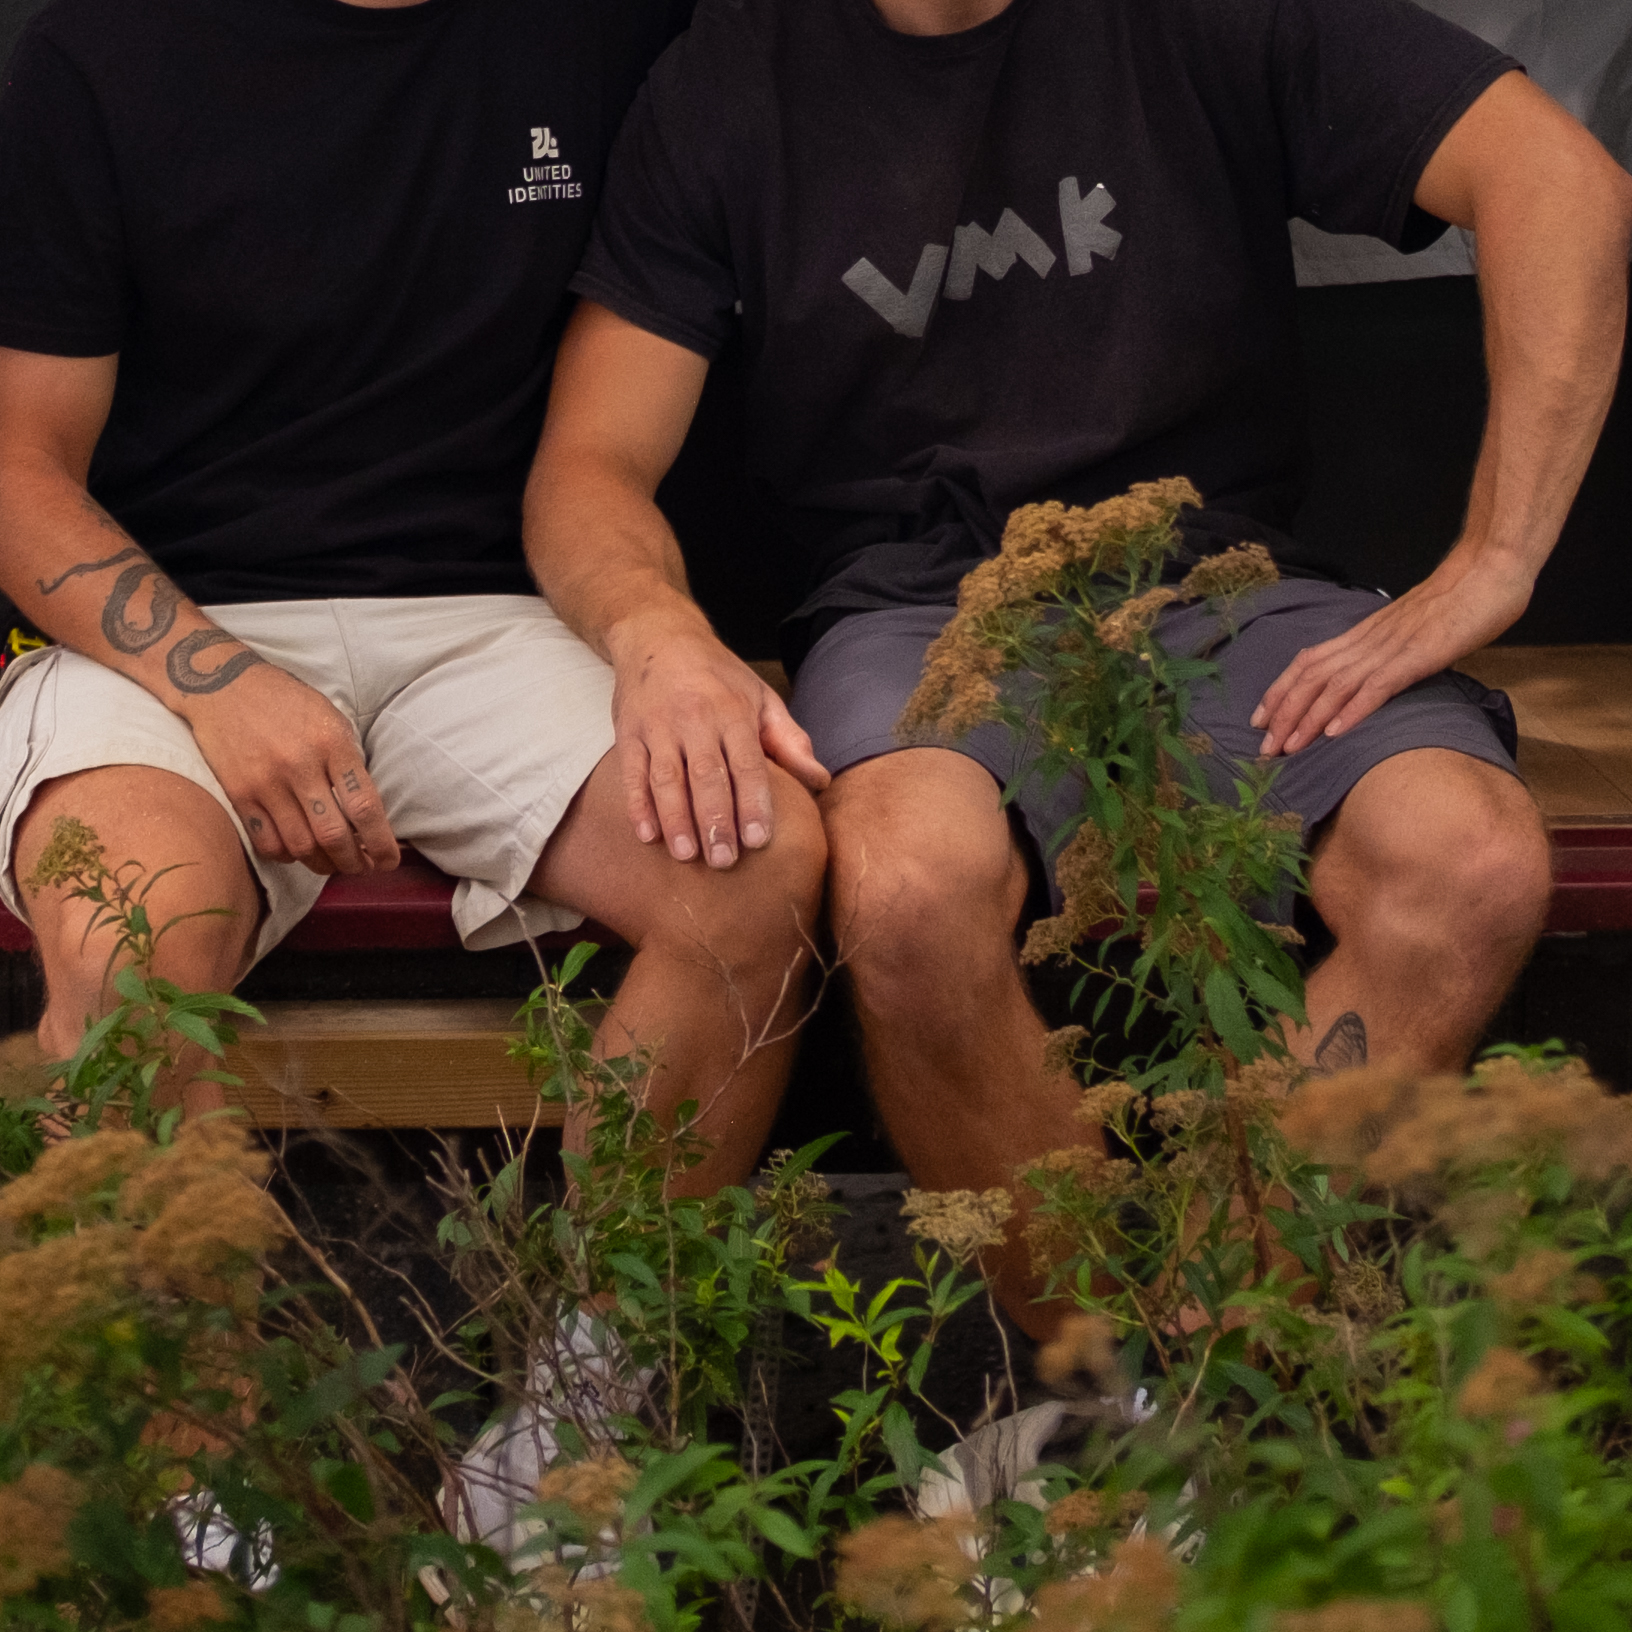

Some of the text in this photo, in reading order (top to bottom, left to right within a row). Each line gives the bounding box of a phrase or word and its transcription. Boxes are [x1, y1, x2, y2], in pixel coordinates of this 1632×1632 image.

[523, 164, 572, 182] UNITED
[508, 183, 582, 204] IDENTITIES
[841, 176, 1123, 338] VMK
